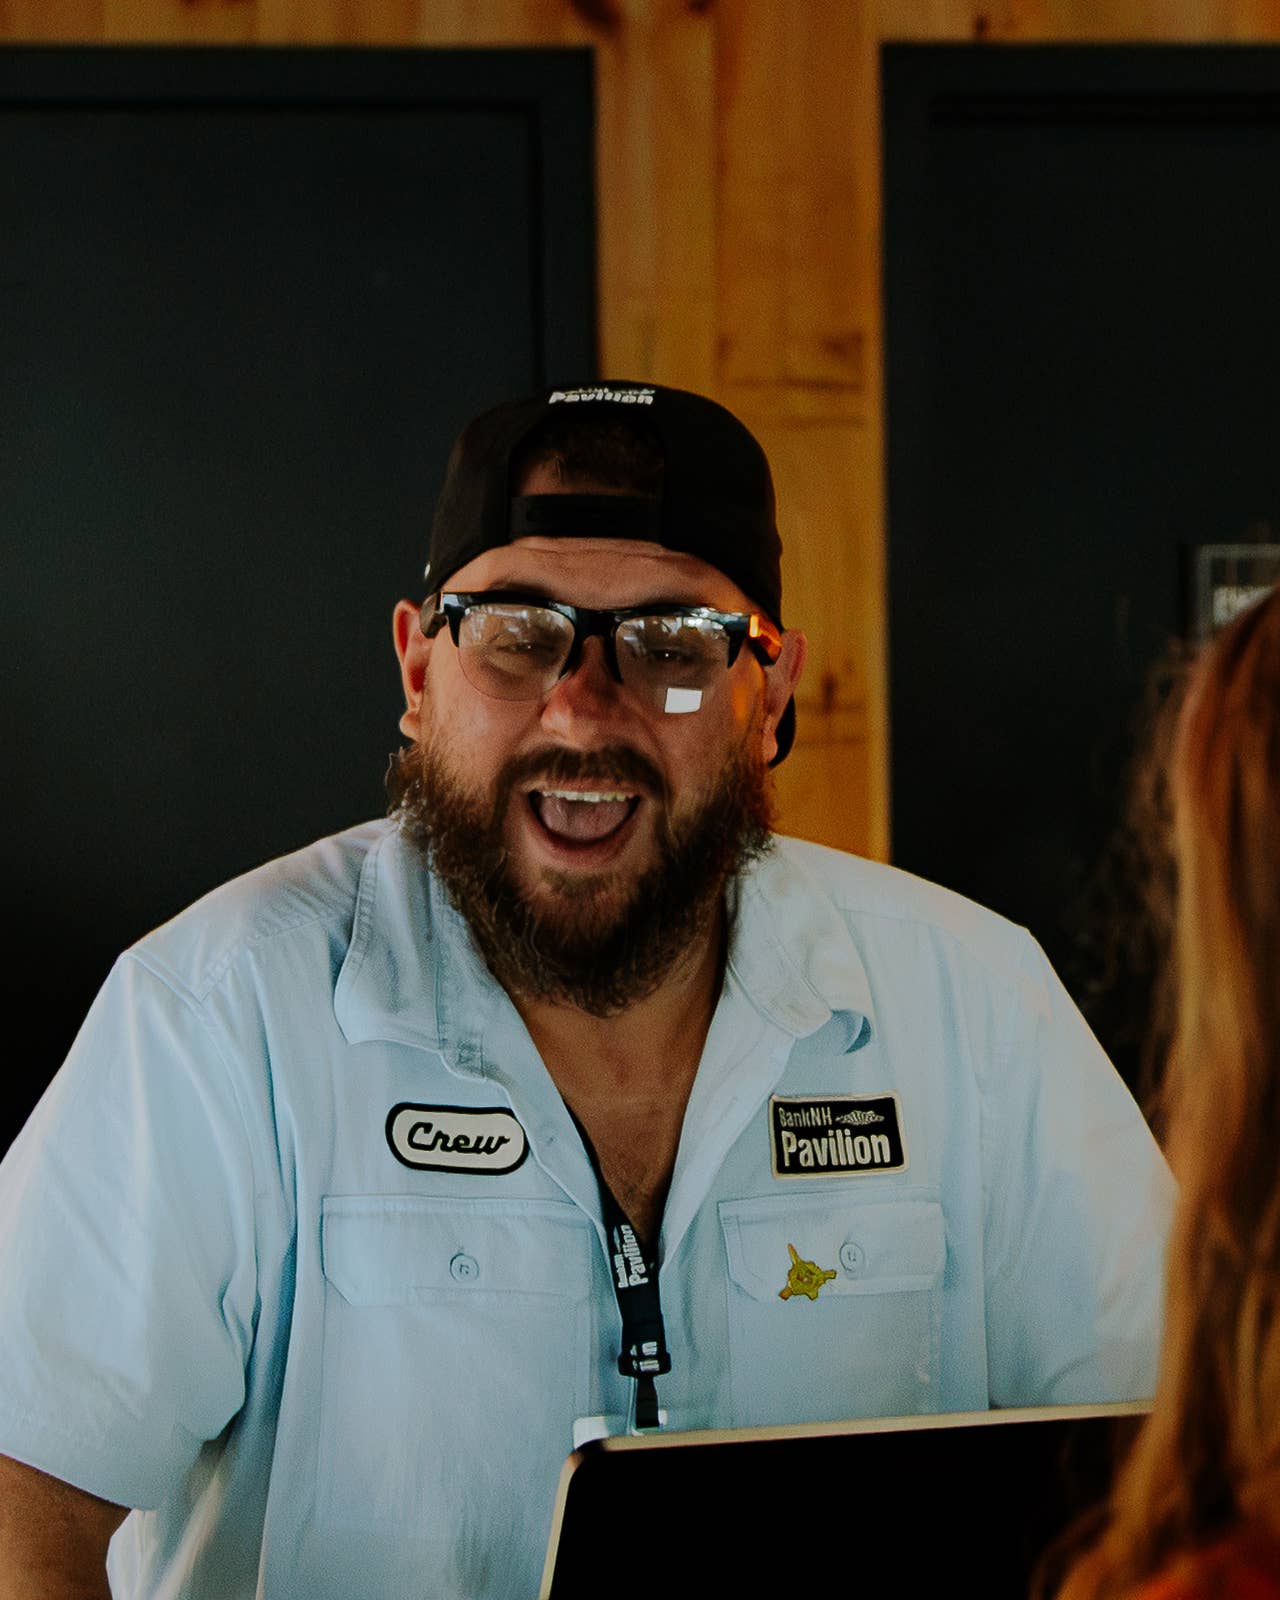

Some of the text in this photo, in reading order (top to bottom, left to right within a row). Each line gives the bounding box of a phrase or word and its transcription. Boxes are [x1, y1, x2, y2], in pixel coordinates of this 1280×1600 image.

[407, 1121, 511, 1155] Crew
[781, 1128, 892, 1168] Pavilion
[620, 1224, 649, 1287] Pavilion
